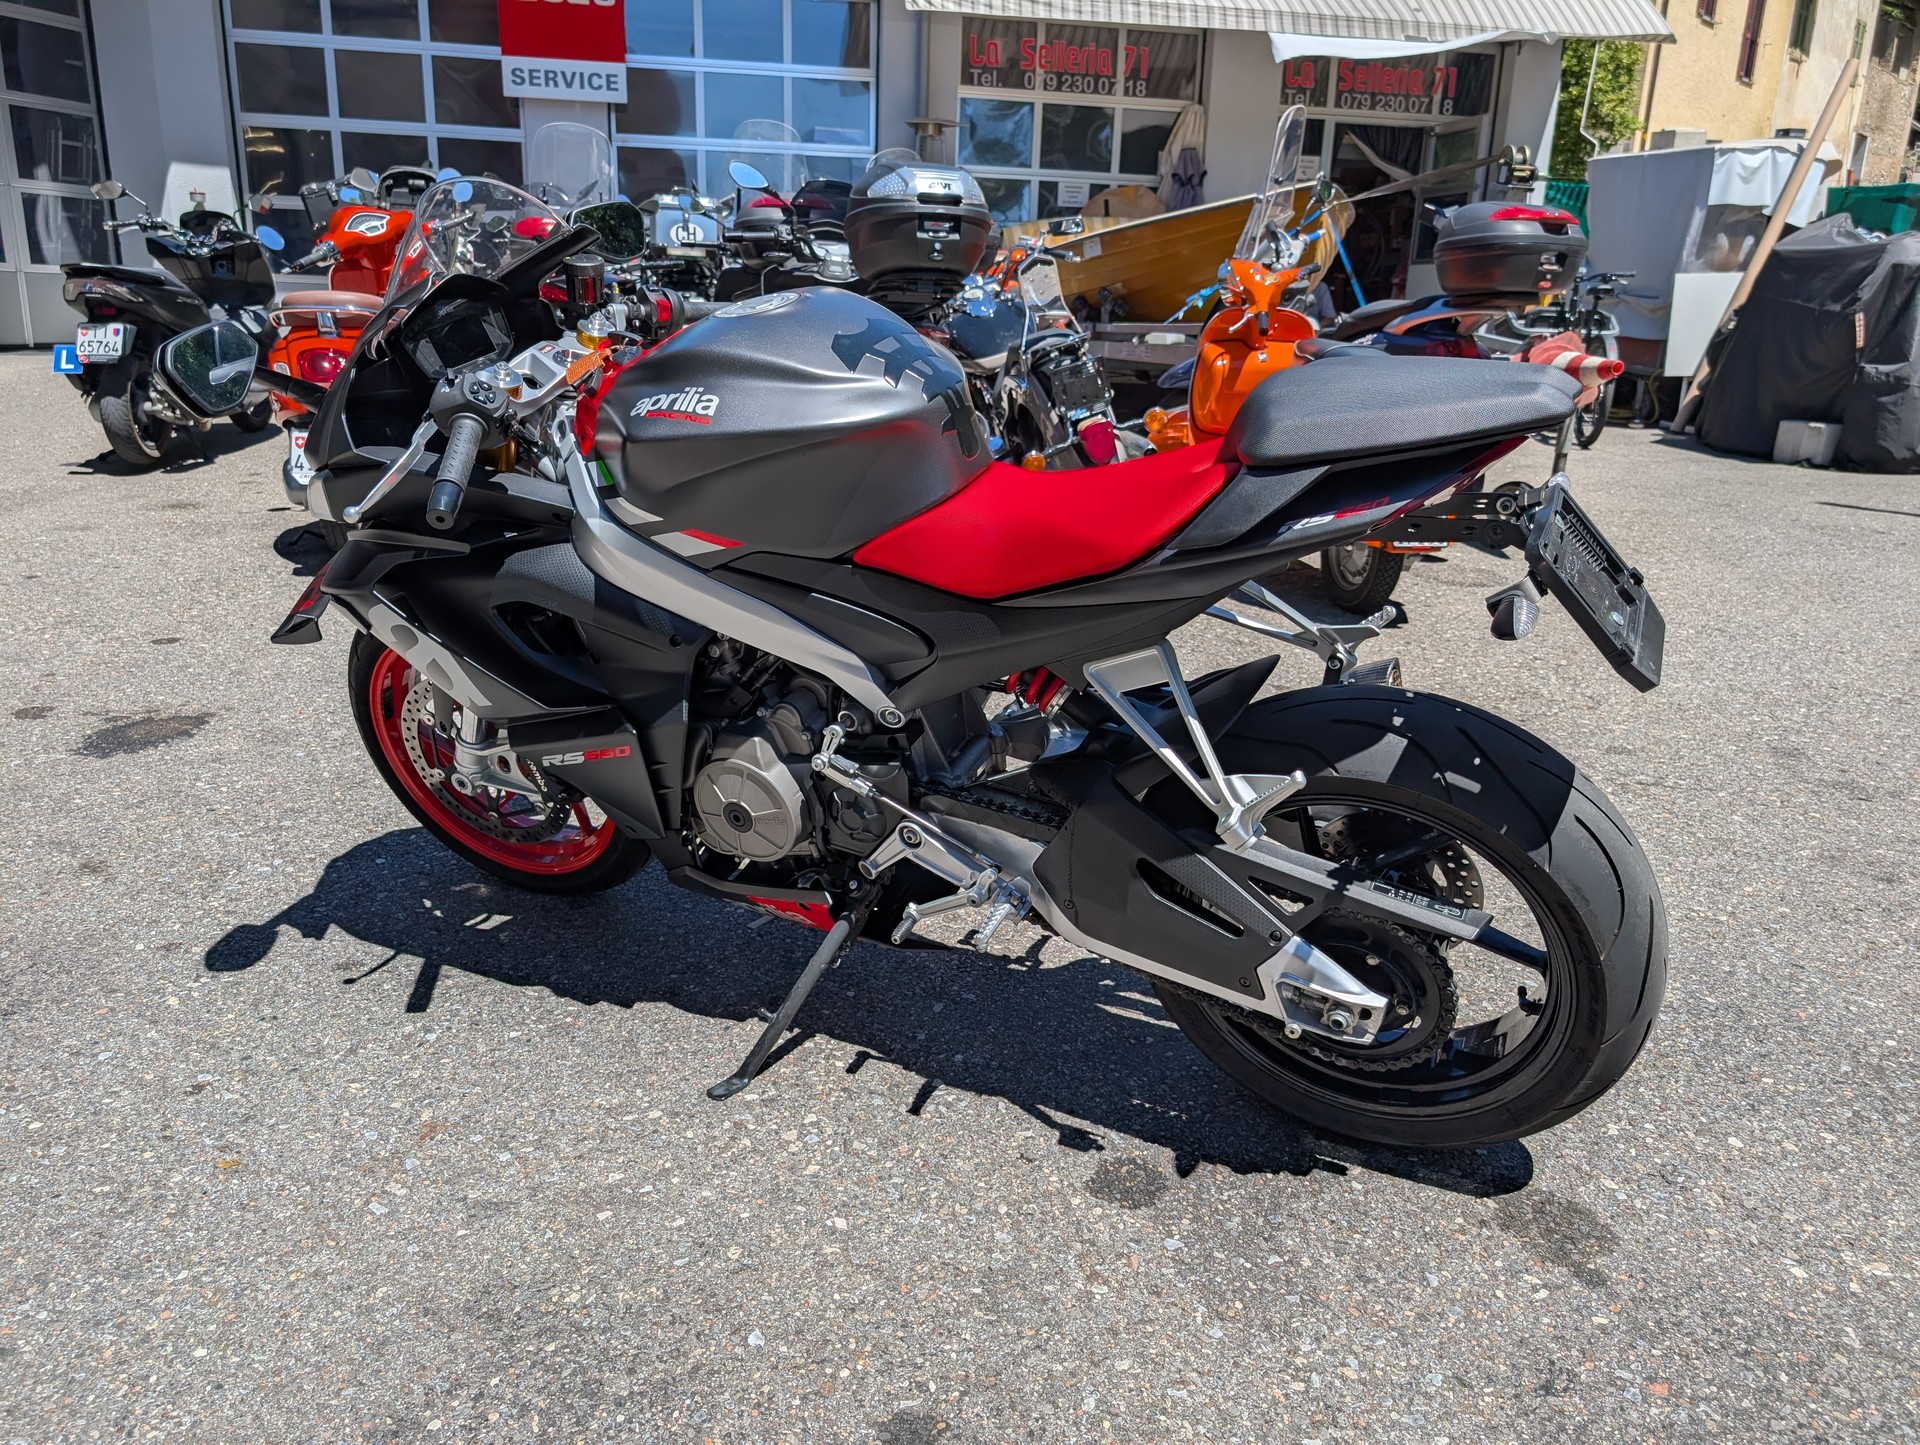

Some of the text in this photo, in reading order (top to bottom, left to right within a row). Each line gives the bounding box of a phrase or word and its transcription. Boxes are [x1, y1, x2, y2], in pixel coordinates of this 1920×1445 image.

[969, 34, 1149, 79] La Selleria 71
[510, 67, 620, 92] SERVICE
[969, 69, 1003, 88] Tel.
[1061, 74, 1095, 94] 230
[1125, 80, 1148, 98] 18
[1284, 60, 1458, 98] La Selleria 71
[1285, 89, 1315, 107] Tel.
[1340, 92, 1372, 111] 079
[1374, 95, 1406, 113] 230
[1408, 97, 1430, 114] 07
[60, 349, 75, 370] L
[79, 340, 119, 354] 65764
[629, 386, 720, 417] aprilia
[541, 745, 631, 767] RS660
[526, 758, 548, 793] rembo
